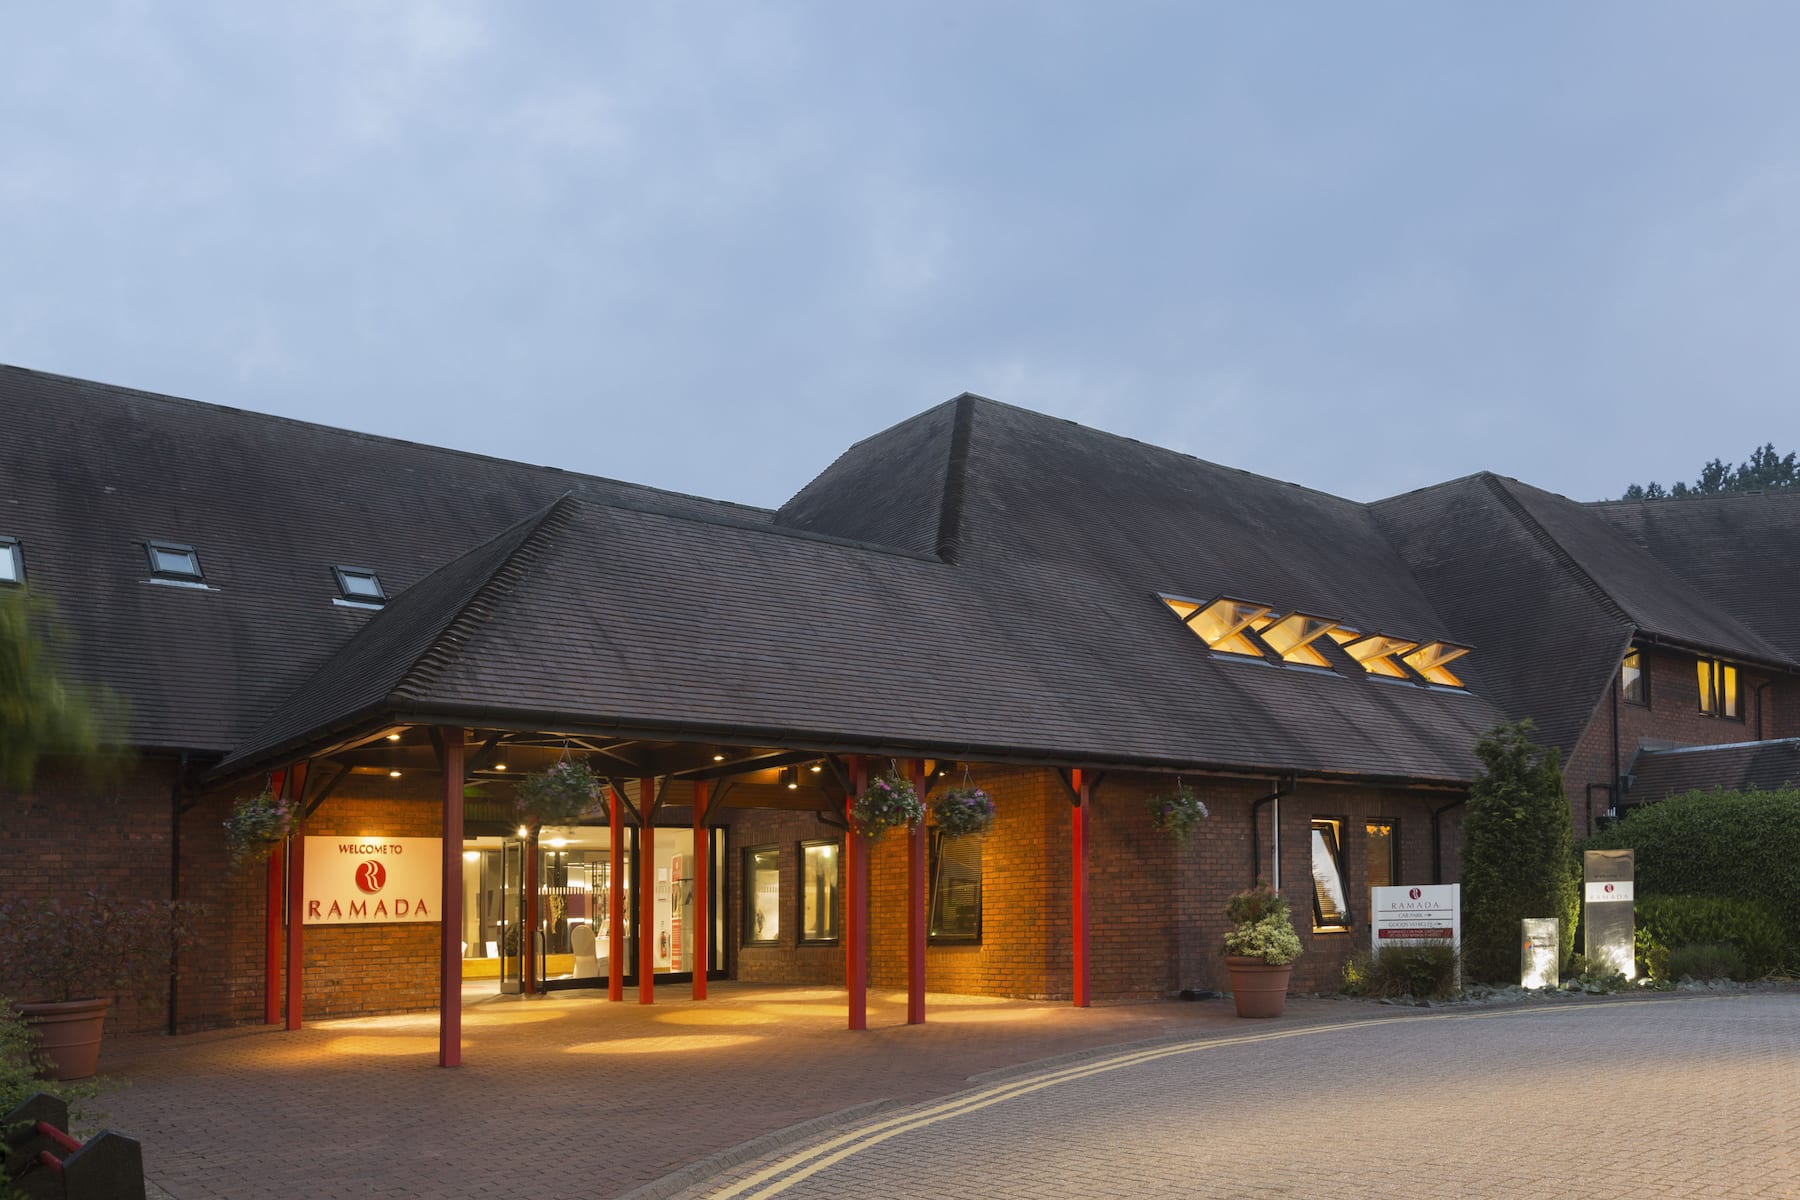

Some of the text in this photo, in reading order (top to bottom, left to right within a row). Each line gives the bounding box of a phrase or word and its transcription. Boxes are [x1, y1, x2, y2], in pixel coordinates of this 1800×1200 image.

[339, 844, 403, 854] WELCOME TO
[308, 898, 428, 918] RAMADA
